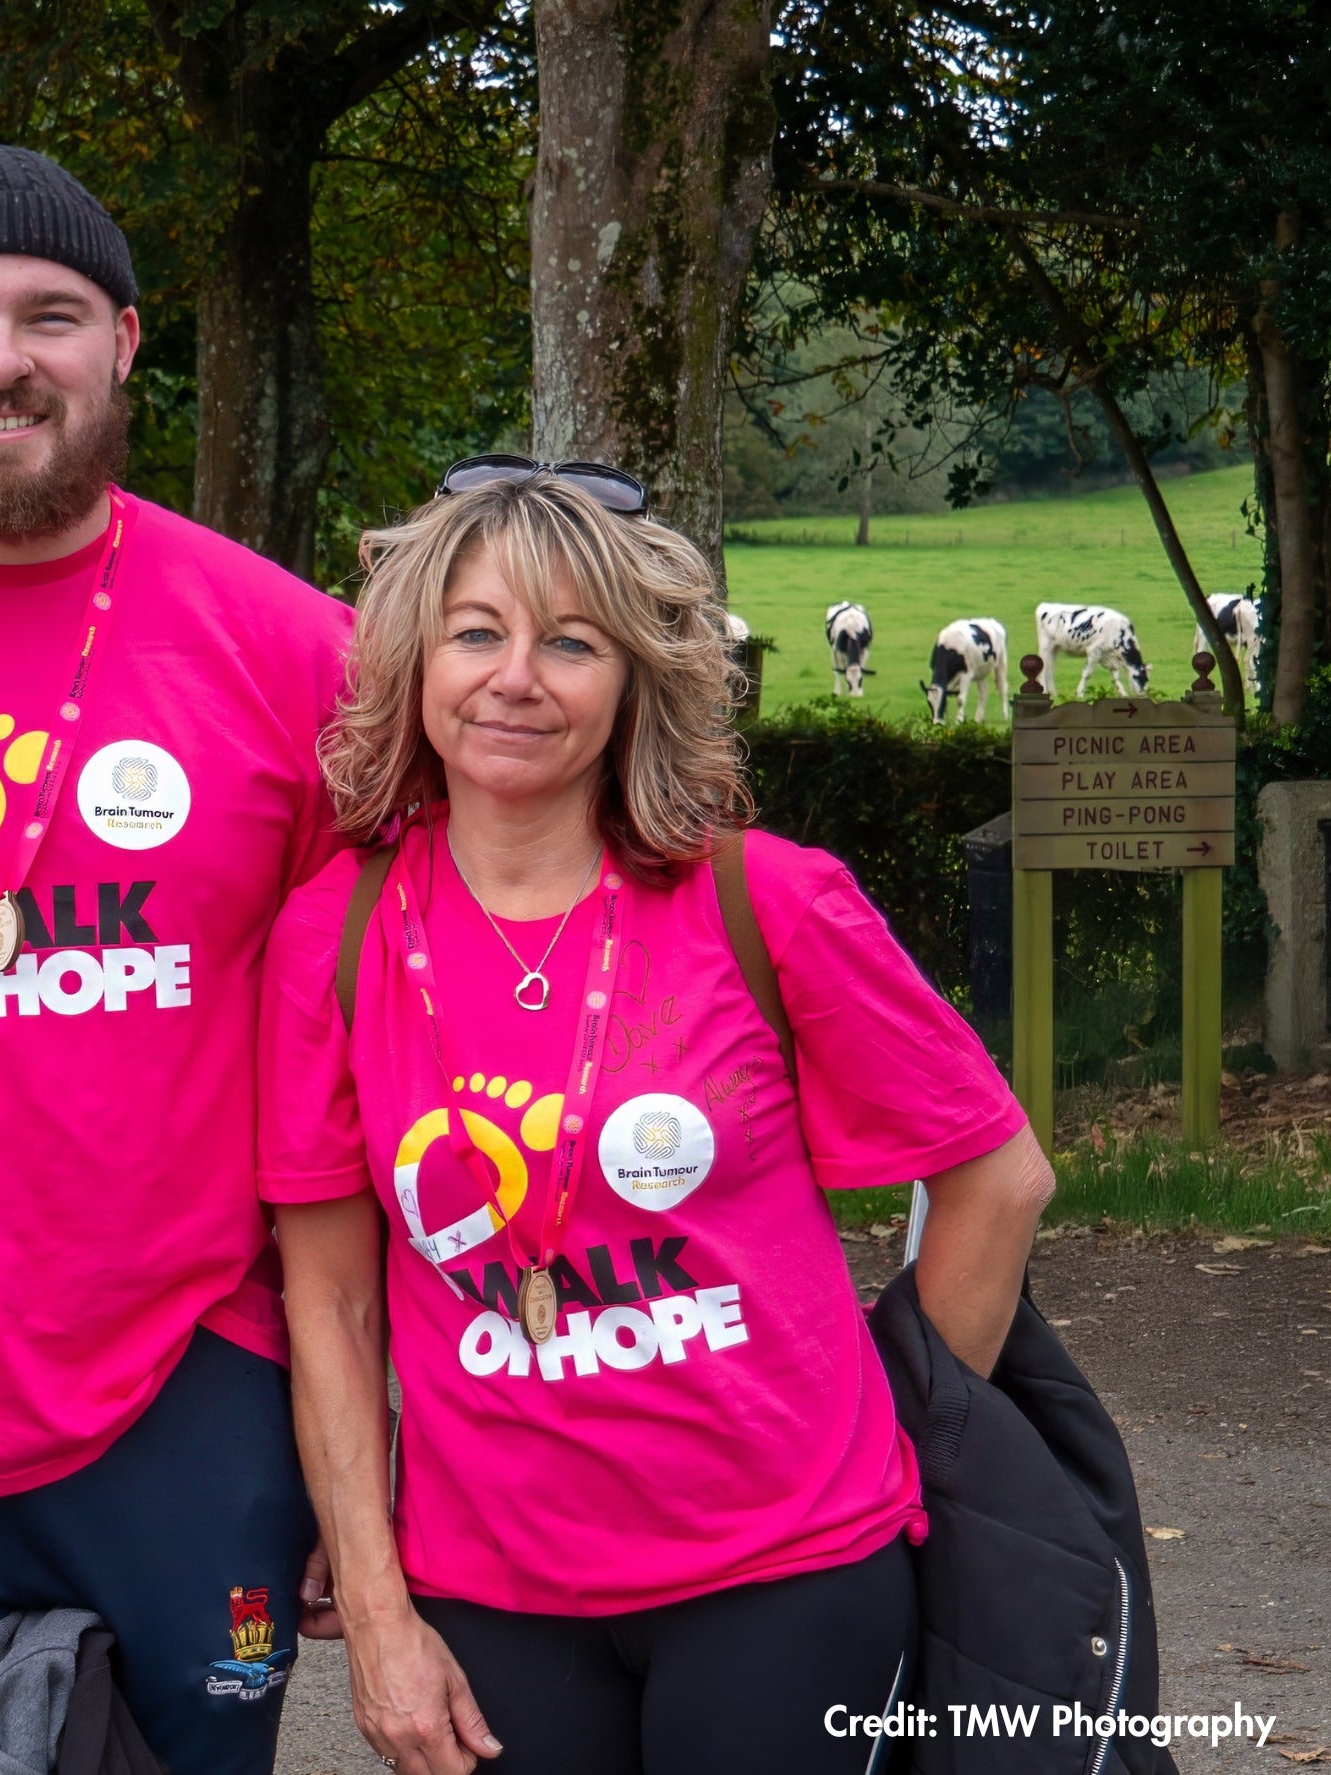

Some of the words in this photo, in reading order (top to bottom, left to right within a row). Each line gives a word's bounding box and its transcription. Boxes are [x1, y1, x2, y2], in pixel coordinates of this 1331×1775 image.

[1053, 736, 1125, 756] PICNIC
[1139, 735, 1196, 754] AREA
[1061, 771, 1116, 791] PLAY
[1130, 770, 1188, 789] AREA
[94, 806, 128, 817] Brain
[128, 806, 175, 819] Tumour
[1062, 804, 1186, 827] PING-PONG
[1086, 840, 1165, 861] TOILET
[600, 995, 682, 1073] Dave
[617, 1167, 652, 1179] Brain
[652, 1166, 698, 1178] Tumour
[631, 1176, 686, 1190] Research
[535, 1284, 749, 1382] HOPE
